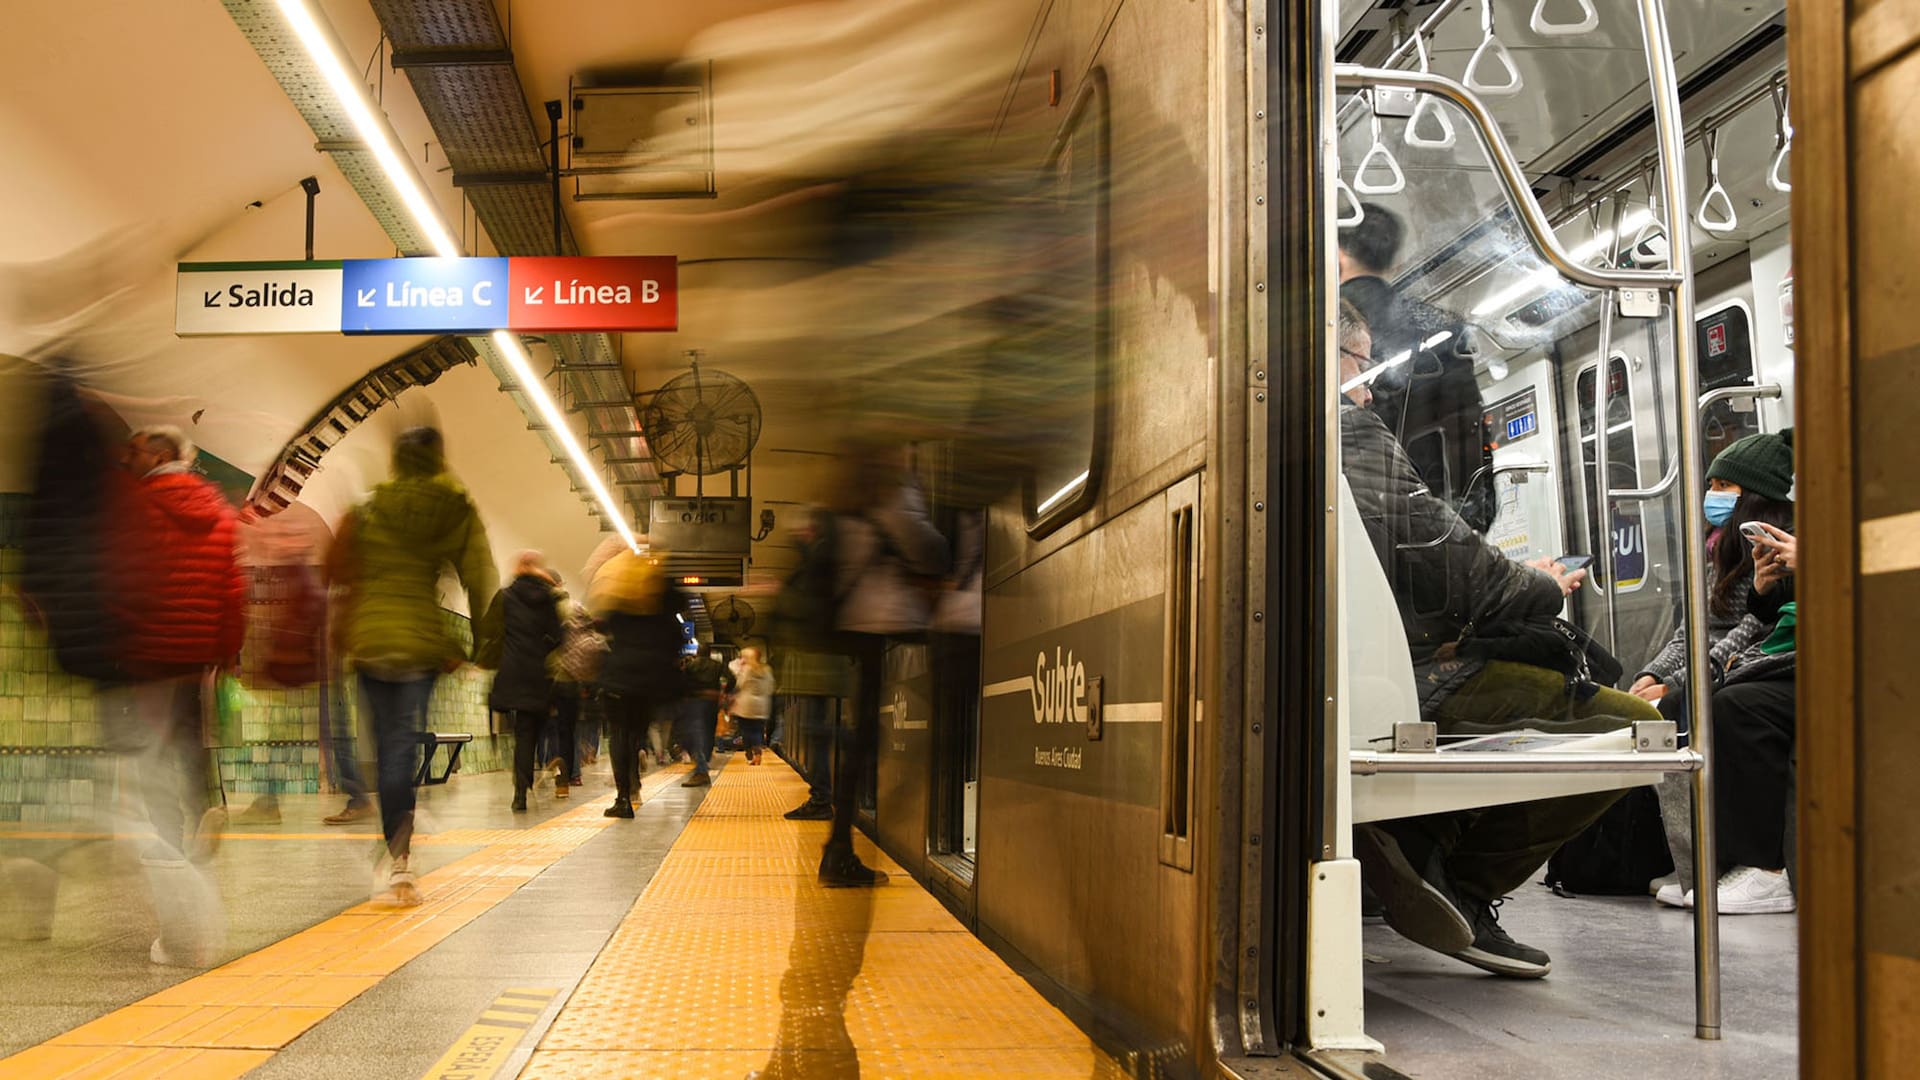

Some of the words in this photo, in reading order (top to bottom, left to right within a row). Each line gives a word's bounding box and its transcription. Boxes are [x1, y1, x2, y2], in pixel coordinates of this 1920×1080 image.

[228, 282, 314, 308] Salida
[387, 280, 464, 308] Línea
[471, 280, 492, 307] C
[554, 279, 631, 305] Línea
[642, 281, 660, 304] B
[1032, 646, 1086, 724] Subte
